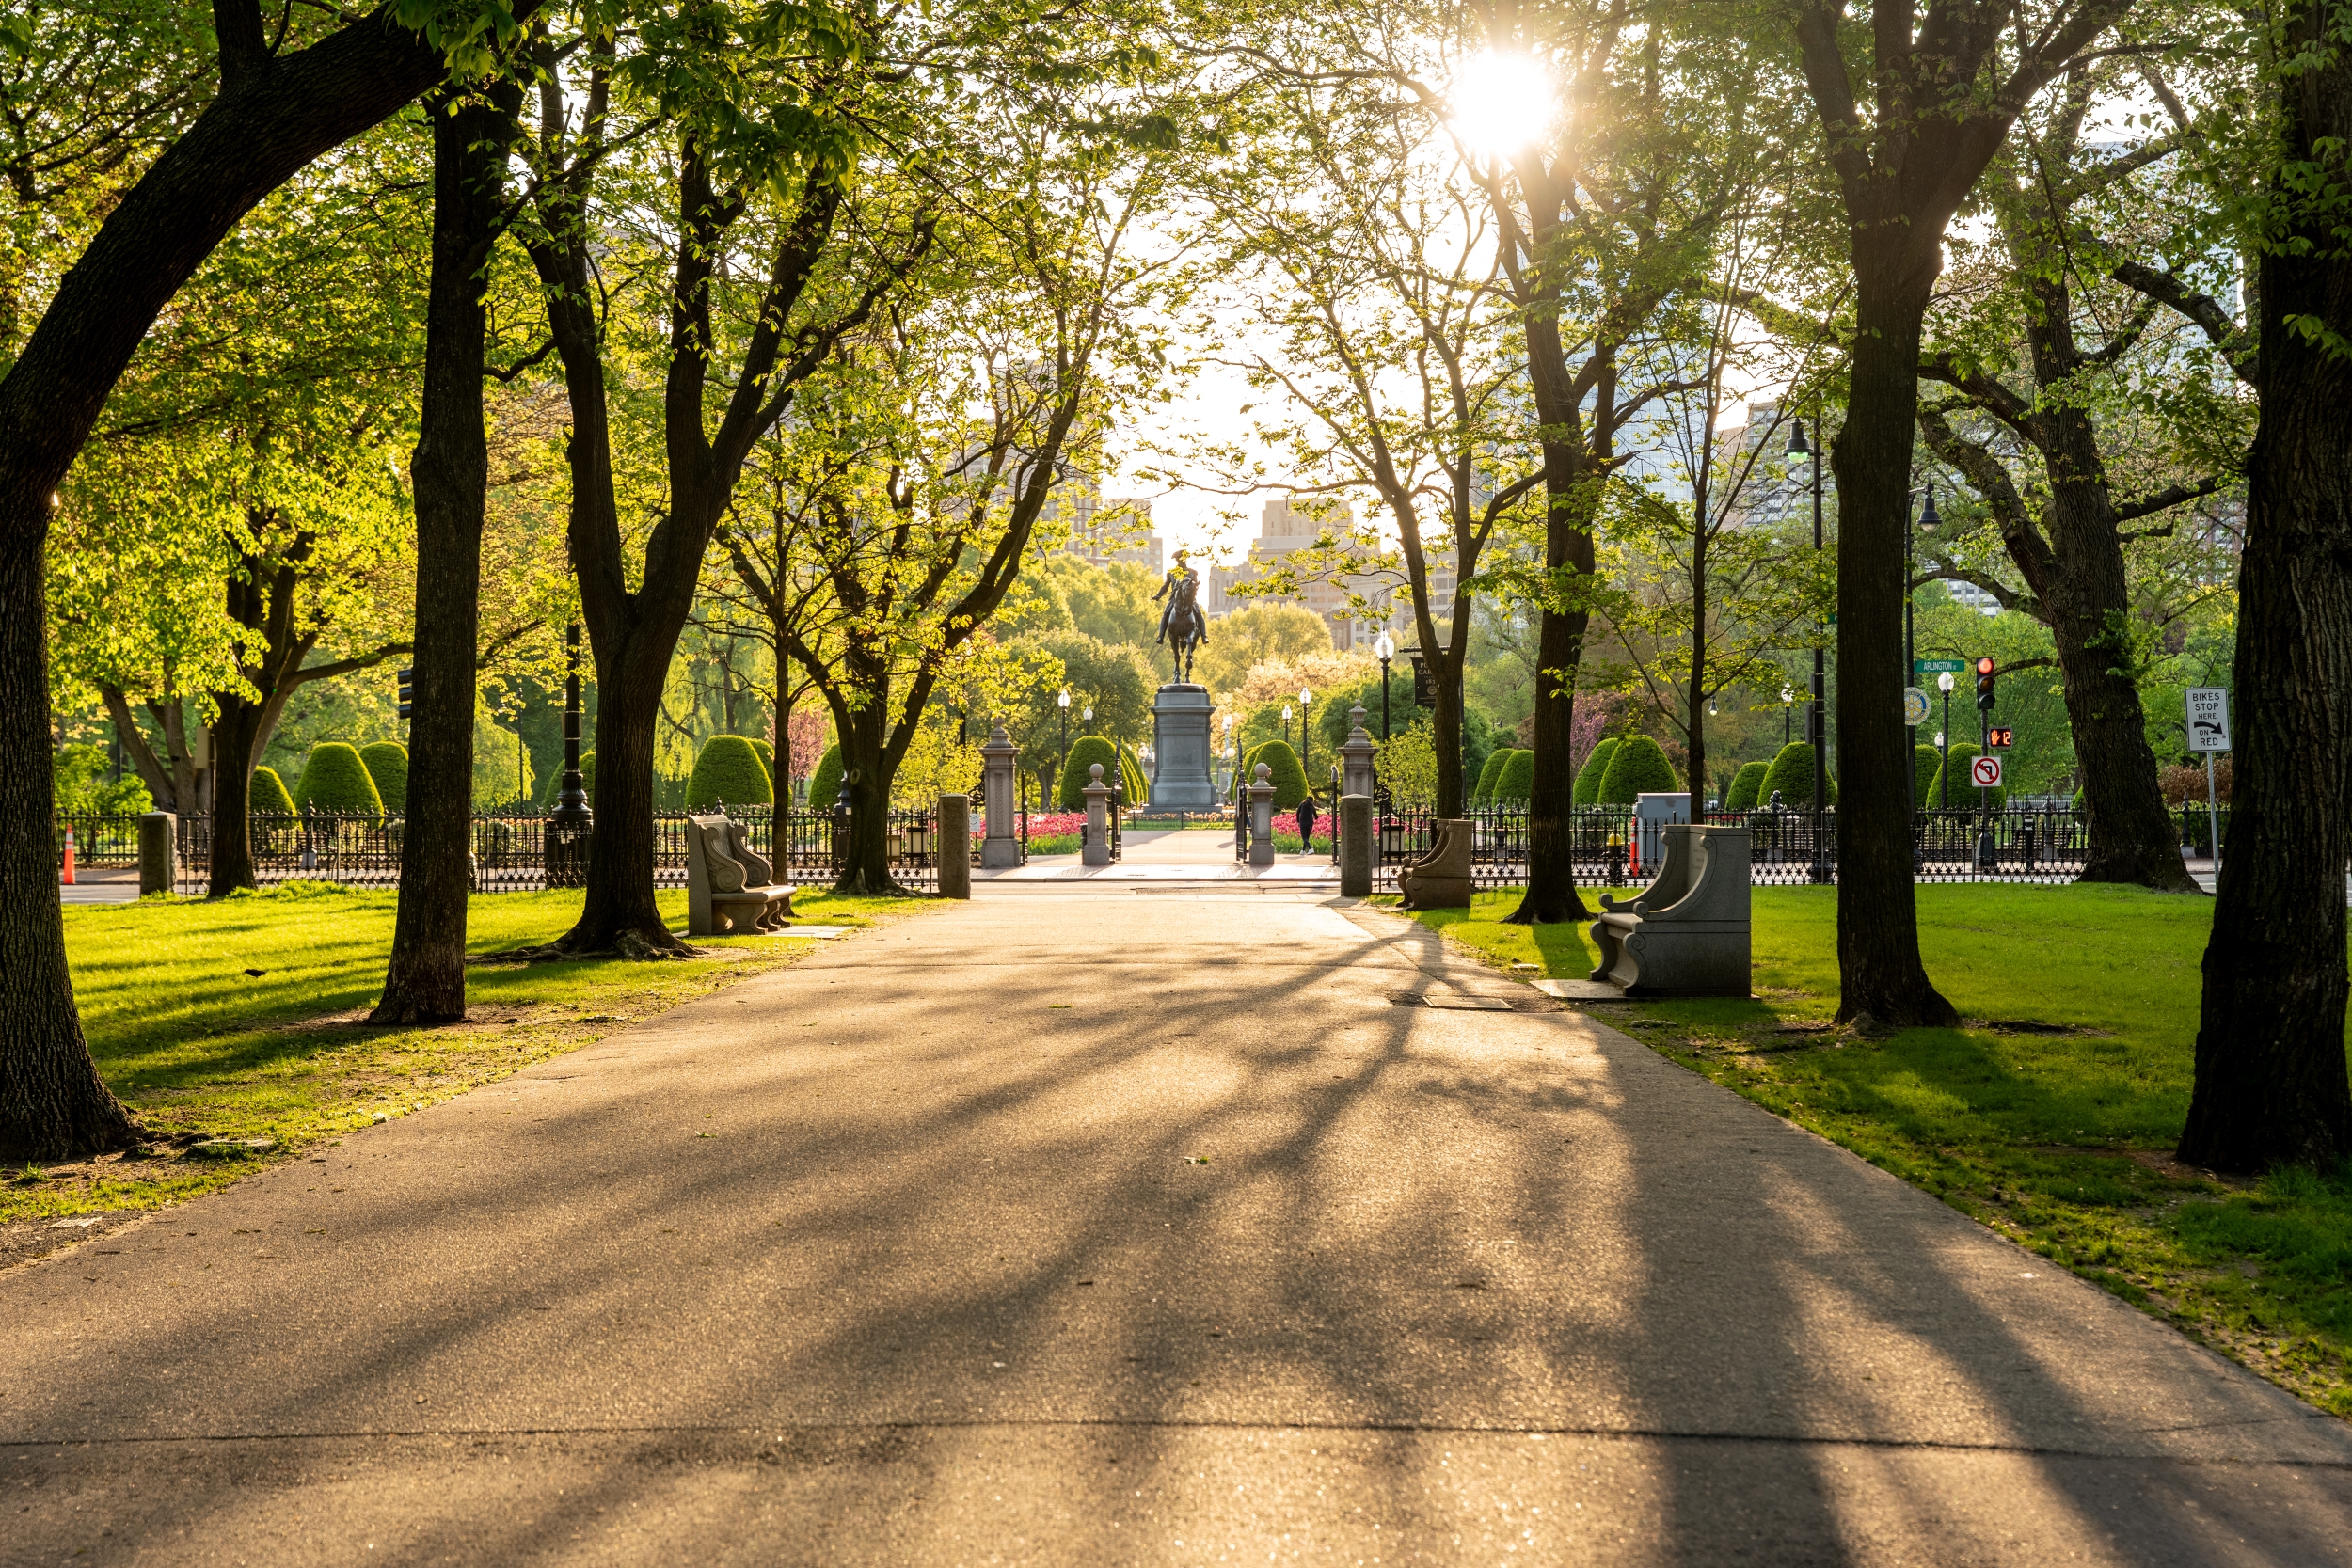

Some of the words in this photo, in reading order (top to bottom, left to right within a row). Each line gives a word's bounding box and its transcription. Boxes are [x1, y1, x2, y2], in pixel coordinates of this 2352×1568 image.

[1923, 661, 1952, 671] ARLINGTON
[2192, 692, 2220, 702] BIKES
[2194, 702, 2219, 711] STOP
[2003, 731, 2010, 744] 12
[2200, 737, 2218, 746] RED
